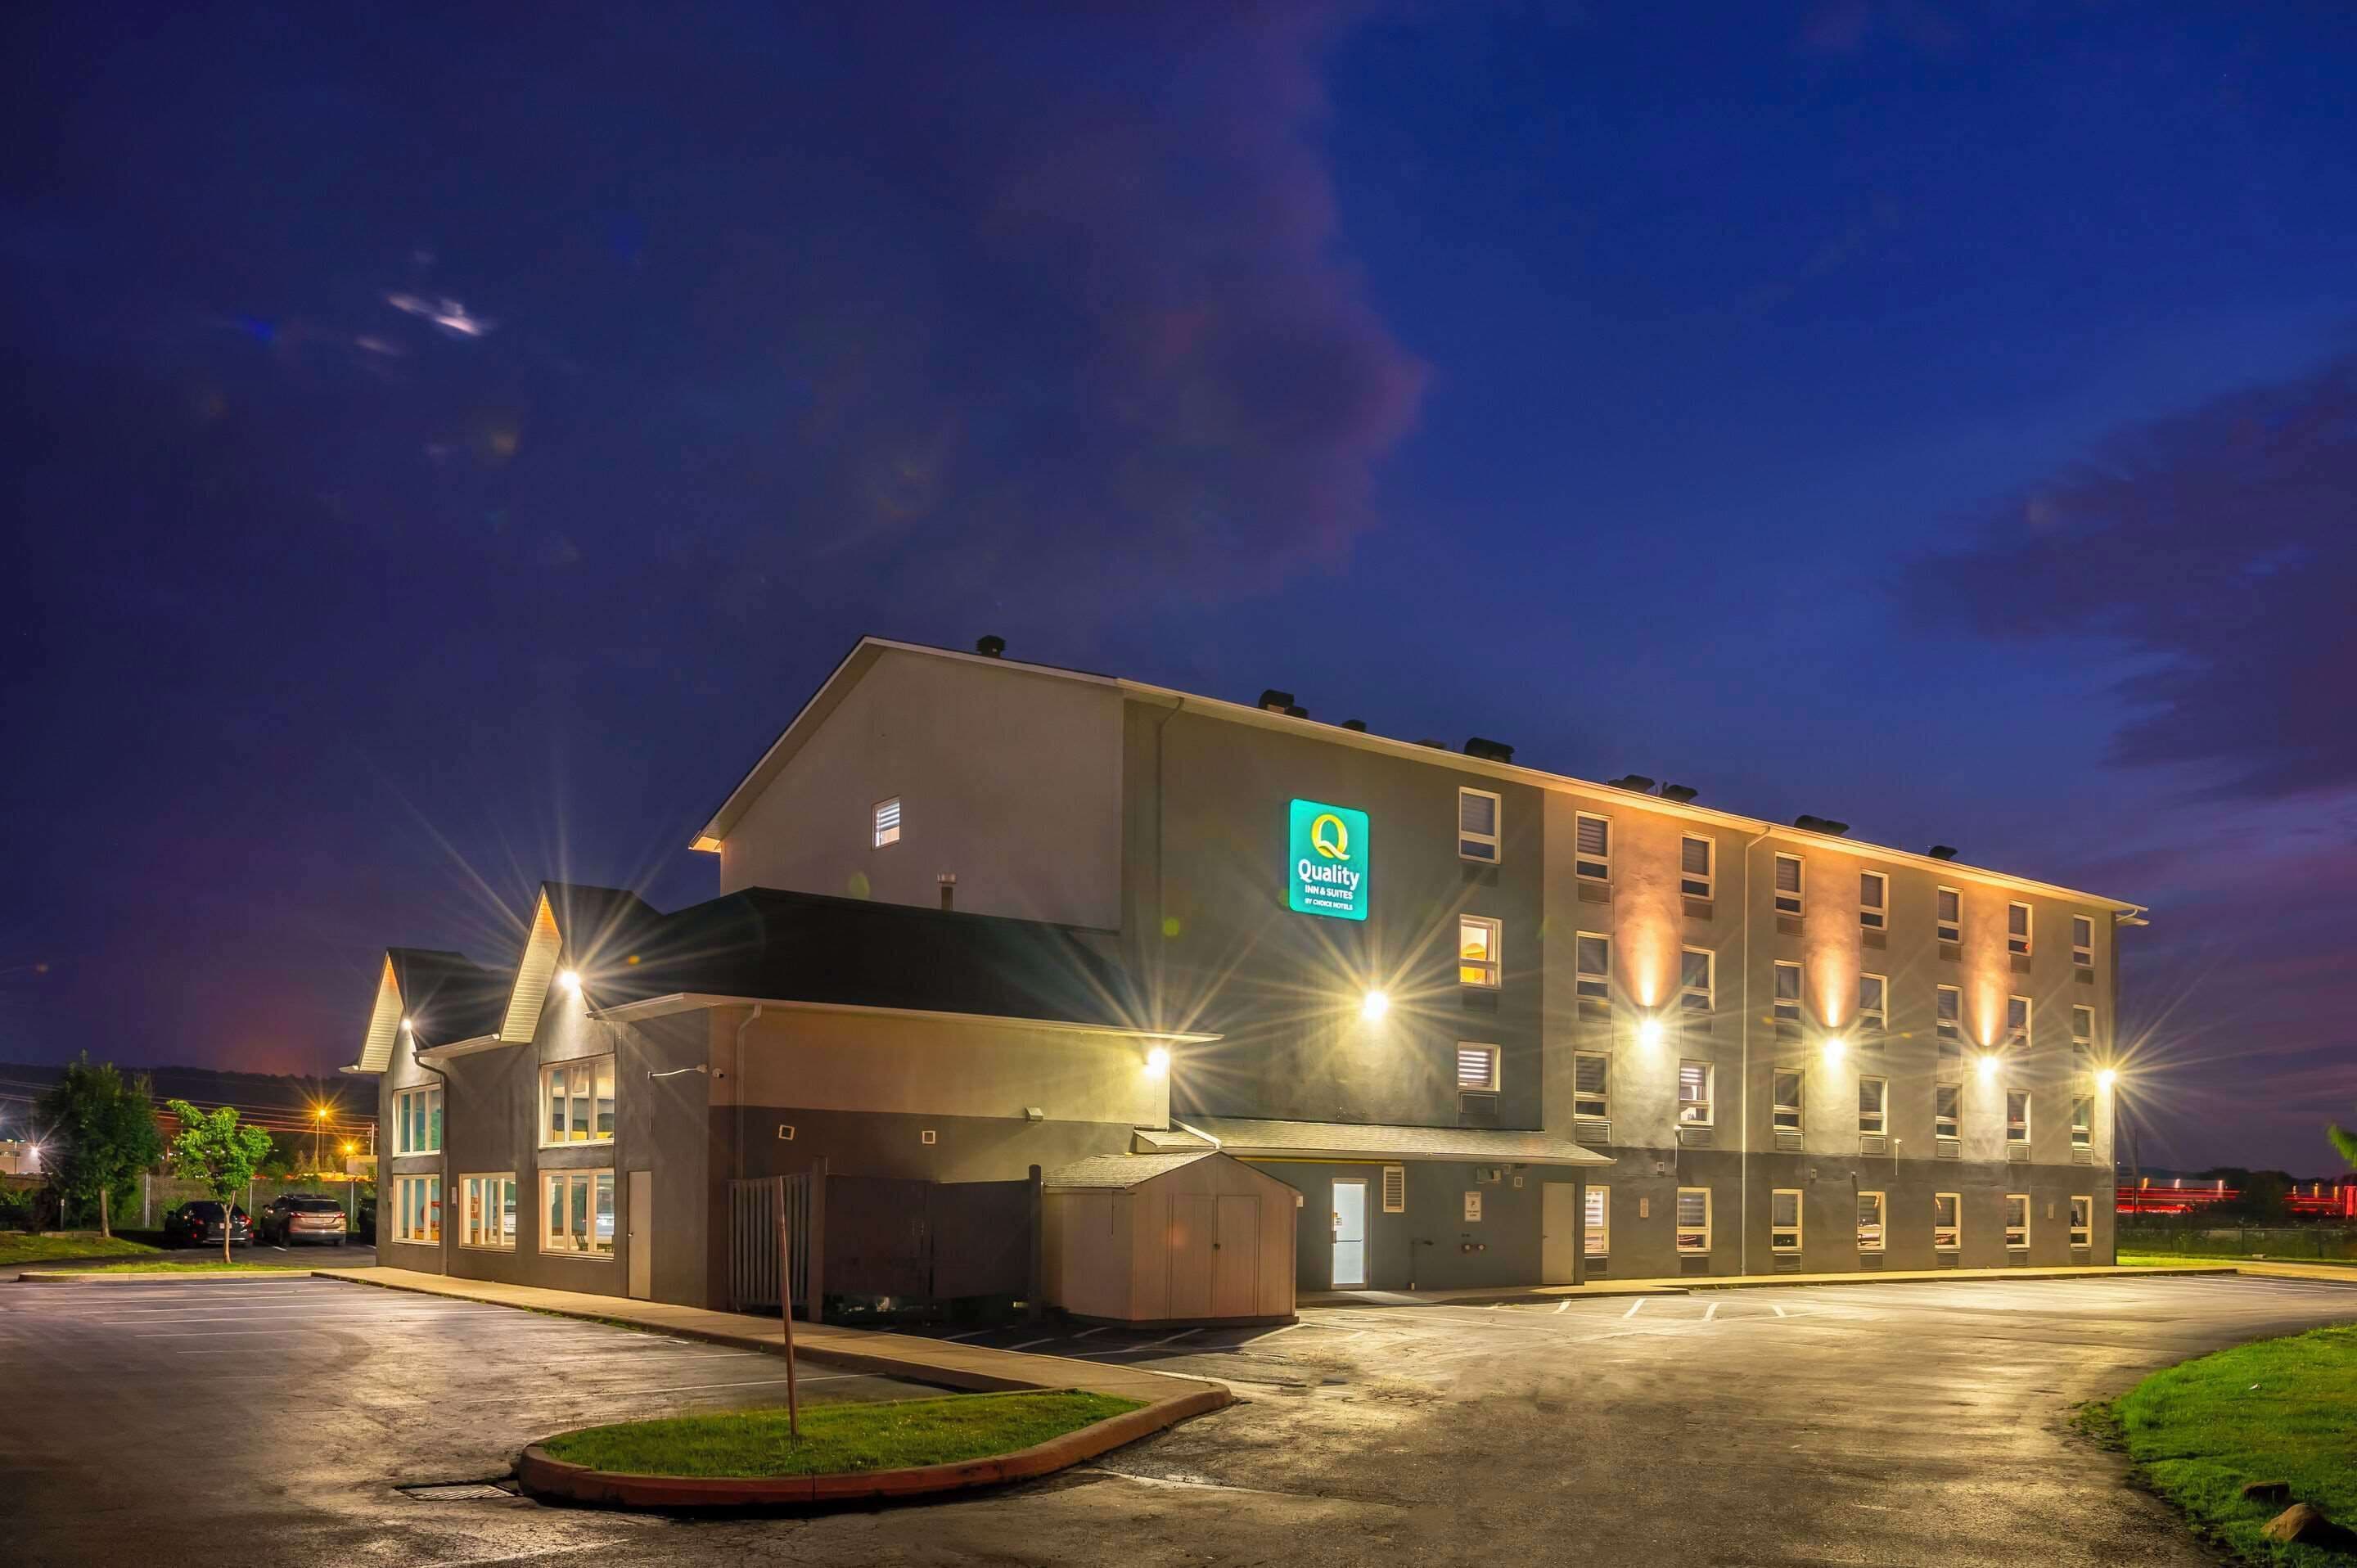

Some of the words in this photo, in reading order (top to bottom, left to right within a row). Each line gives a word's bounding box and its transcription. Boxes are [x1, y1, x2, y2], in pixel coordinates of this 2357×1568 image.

[1312, 813, 1350, 860] Q
[1298, 858, 1360, 890] Quality
[1305, 885, 1319, 894] INN
[1320, 886, 1326, 896] &
[1327, 888, 1353, 900] SUITES
[1313, 899, 1332, 908] CHOICE
[1333, 901, 1353, 910] HOTELS
